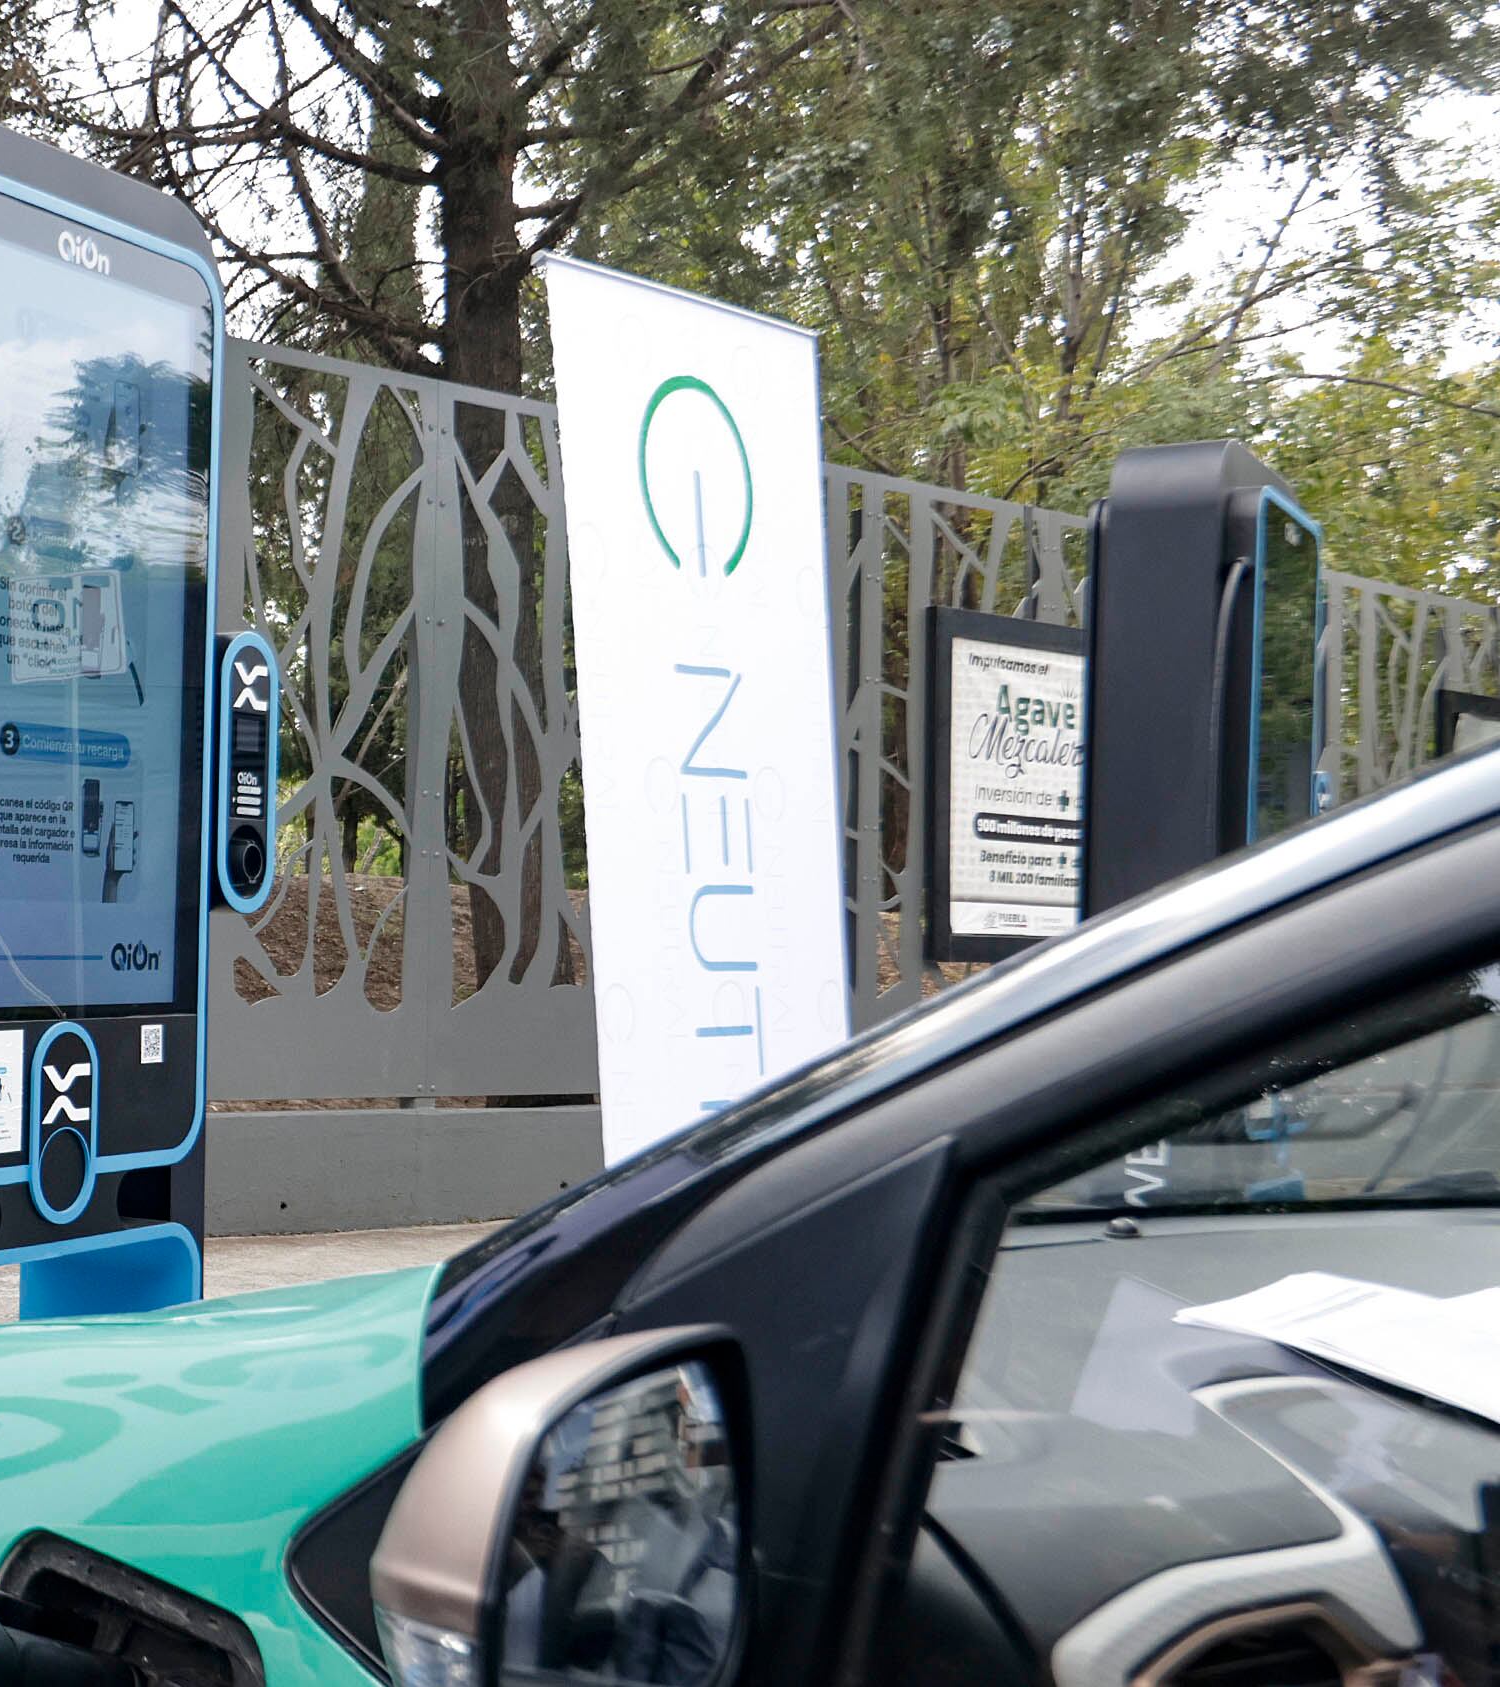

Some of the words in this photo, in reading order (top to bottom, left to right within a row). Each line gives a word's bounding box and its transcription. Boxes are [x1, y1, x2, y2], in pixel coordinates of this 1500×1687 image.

[58, 231, 110, 276] QiOn
[0, 576, 16, 592] Sin
[19, 582, 57, 597] oprimir
[58, 588, 67, 600] el
[8, 596, 39, 613] botón
[42, 602, 58, 616] del
[42, 621, 71, 636] hasta
[18, 638, 68, 654] escuches
[6, 654, 20, 664] un
[969, 653, 1036, 674] Impulsamos
[1038, 664, 1049, 676] el
[997, 684, 1076, 736] Agave
[4, 730, 14, 748] 3
[22, 735, 73, 753] Comienza
[73, 741, 84, 754] tu
[87, 744, 124, 760] recarga
[974, 783, 1032, 805] Inversión
[1036, 789, 1052, 806] de
[26, 798, 32, 809] el
[34, 799, 61, 813] código
[62, 800, 74, 811] QR
[16, 813, 46, 825] aparece
[48, 815, 58, 823] en
[59, 813, 66, 825] la
[977, 818, 996, 833] 900
[996, 820, 1040, 836] millones
[1041, 823, 1054, 837] de
[21, 825, 33, 836] del
[34, 826, 68, 839] cargador
[70, 830, 75, 838] e
[20, 838, 26, 849] la
[28, 838, 74, 851] información
[13, 852, 50, 865] requerida
[980, 850, 1026, 865] Beneficio
[1028, 856, 1052, 869] para
[672, 663, 766, 1111] NEUT
[996, 871, 1014, 884] MIL
[1015, 873, 1033, 885] 200
[111, 940, 160, 971] QiOn
